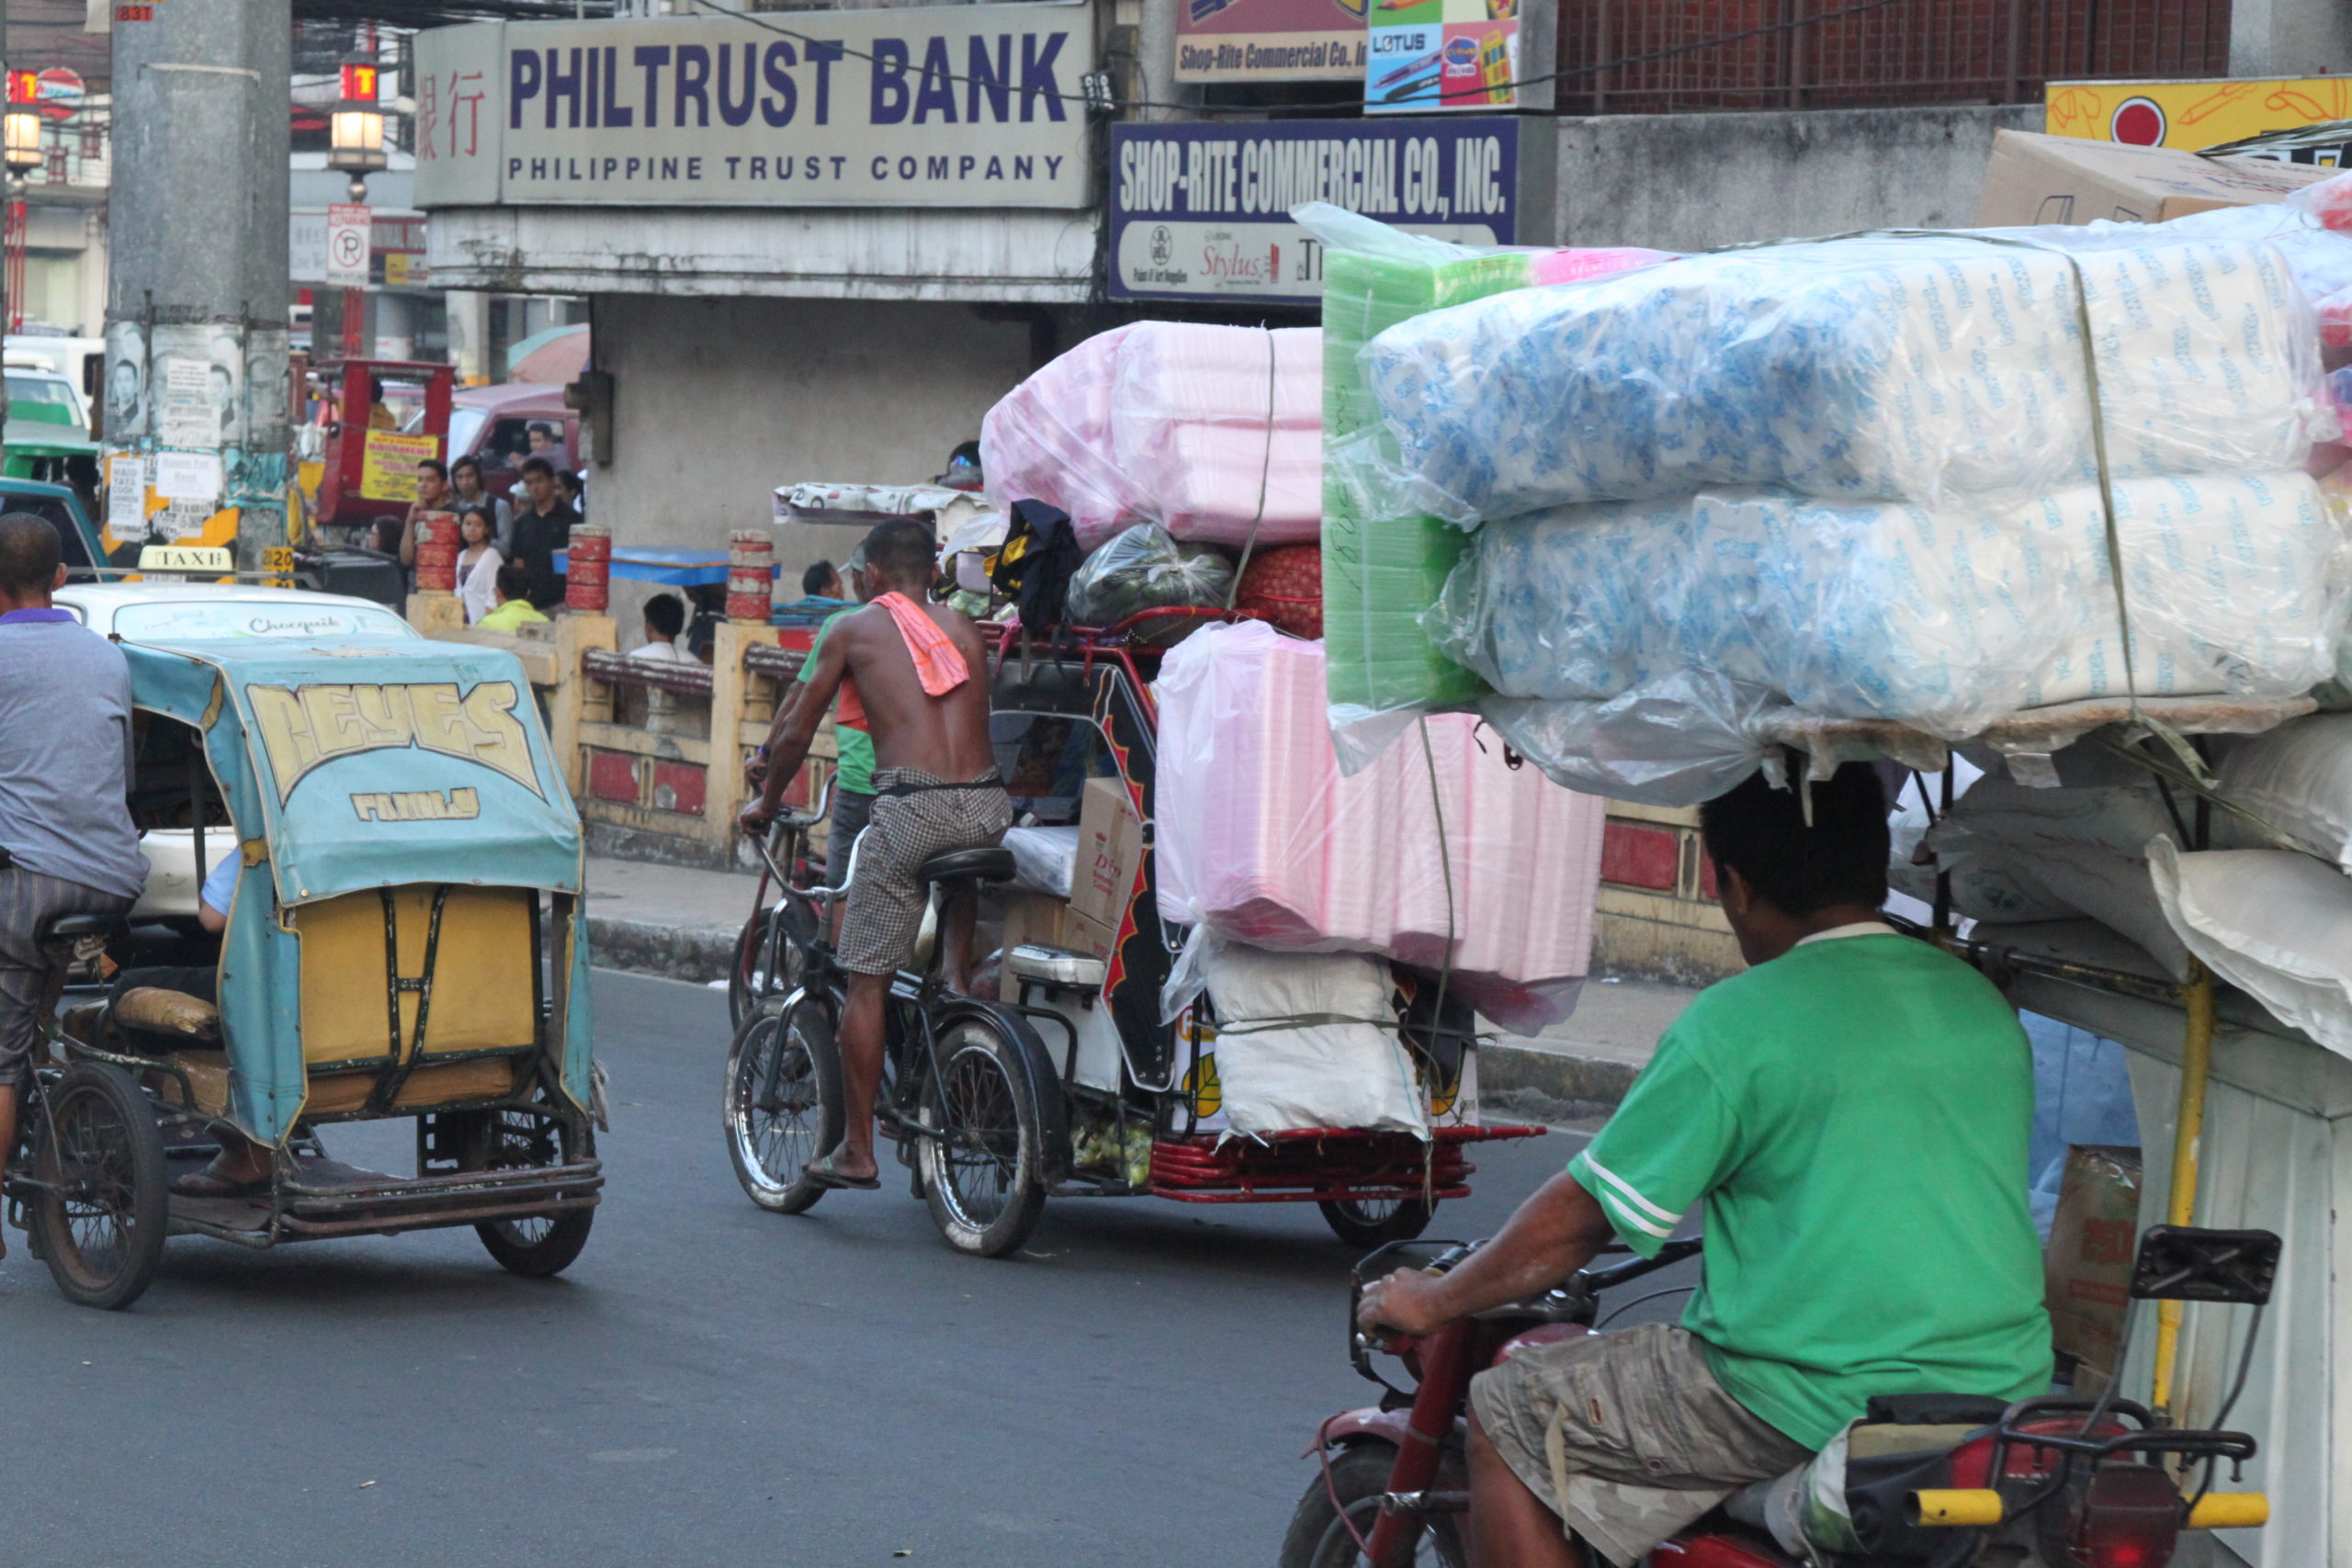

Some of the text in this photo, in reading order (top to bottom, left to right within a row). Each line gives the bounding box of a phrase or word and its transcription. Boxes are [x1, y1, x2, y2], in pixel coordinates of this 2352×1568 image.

[1180, 44, 1243, 73] Shop-Rite
[1245, 40, 1328, 70] Commercial
[1373, 33, 1426, 53] LOTUS
[509, 31, 1069, 130] PHILTRUST BANK
[508, 154, 1065, 181] PHILIPPINE TRUST COMPANY
[1119, 136, 1507, 221] SHOP-RITE COMMERCIAL CO., INC.
[1199, 243, 1261, 288] Stylus
[160, 551, 214, 566] TAXI
[246, 681, 550, 814] REYES
[350, 786, 481, 821] FAMILY
